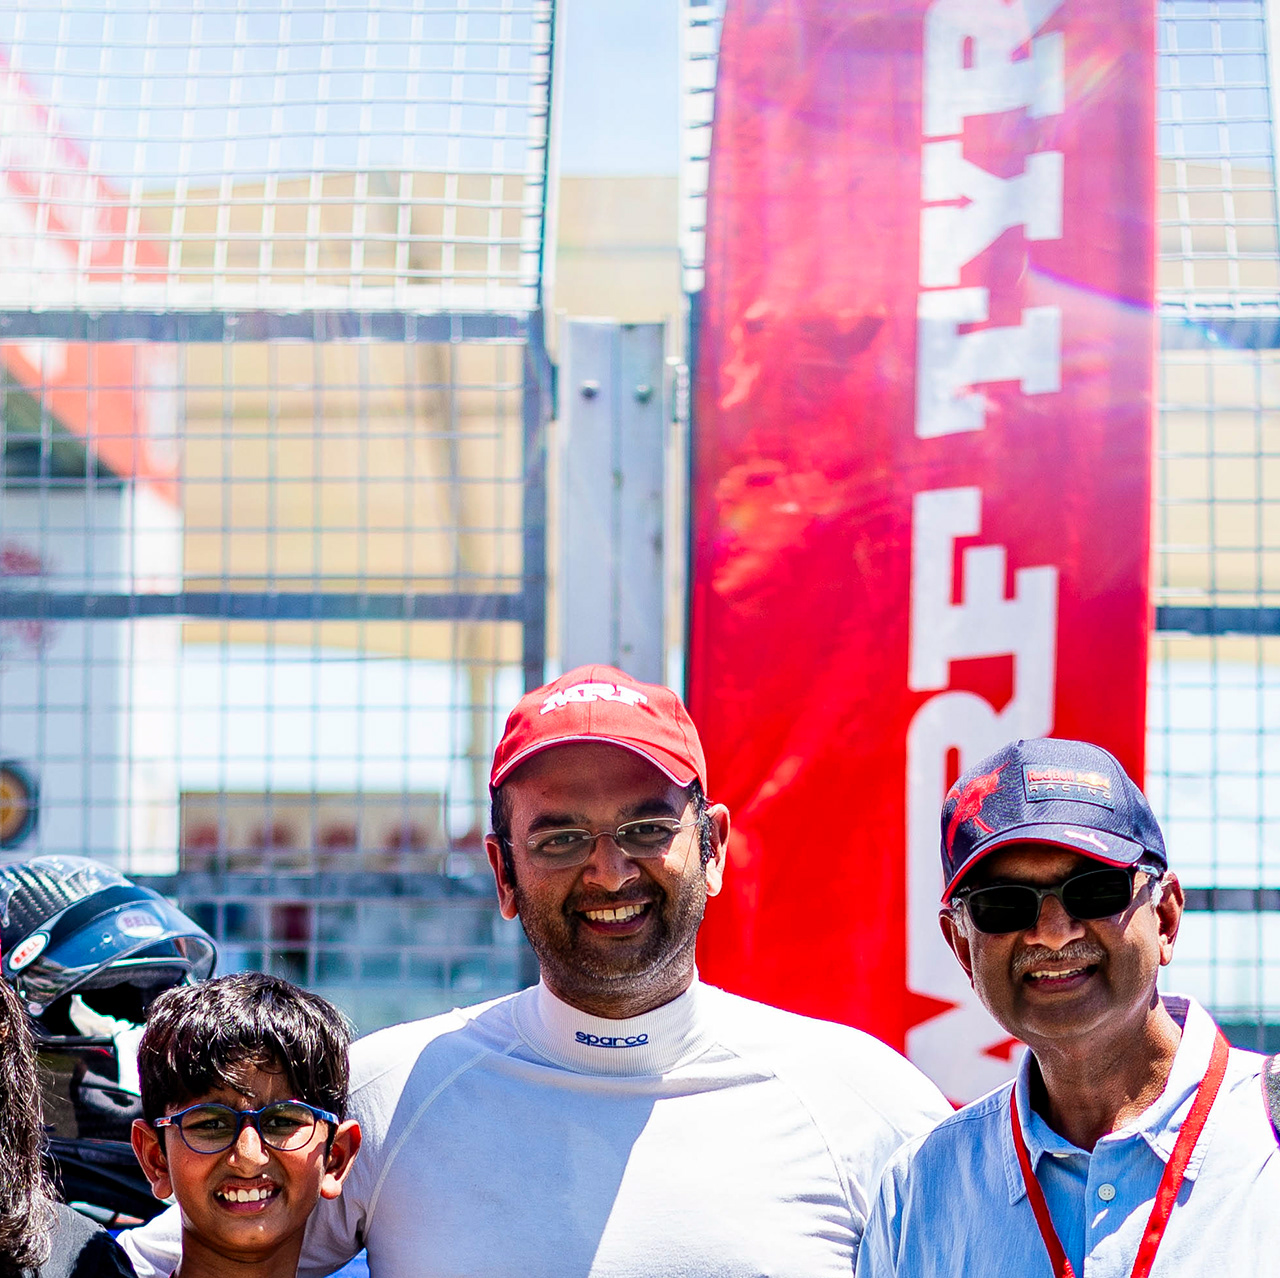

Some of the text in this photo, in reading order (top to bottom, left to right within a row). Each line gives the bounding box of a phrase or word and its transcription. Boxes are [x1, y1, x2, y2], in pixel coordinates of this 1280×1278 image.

[539, 683, 648, 716] MRF
[1029, 784, 1112, 800] RACING
[123, 915, 158, 929] BELL
[14, 940, 39, 965] BELL
[575, 1031, 649, 1048] sparco
